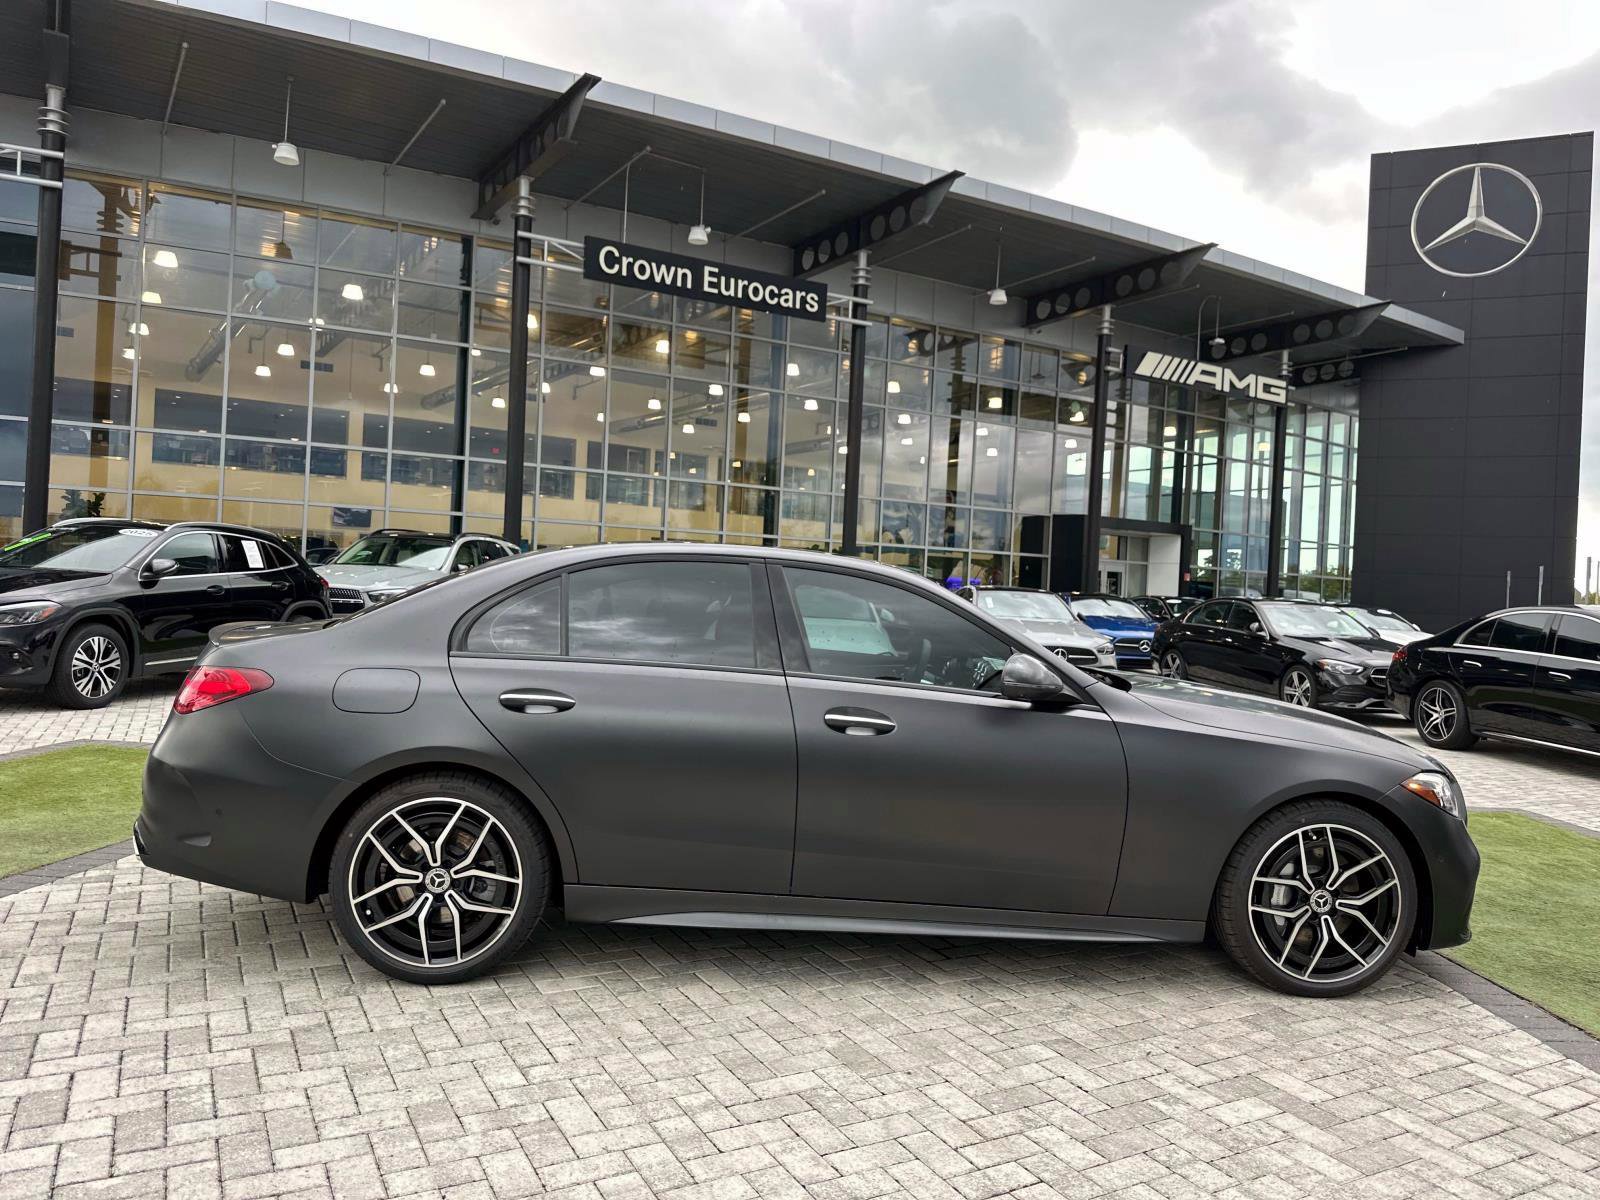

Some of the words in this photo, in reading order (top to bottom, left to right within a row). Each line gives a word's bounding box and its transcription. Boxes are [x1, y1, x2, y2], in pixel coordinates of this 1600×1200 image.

[599, 246, 693, 289] Crown
[703, 266, 819, 312] Eurocars
[1186, 362, 1286, 403] AMG
